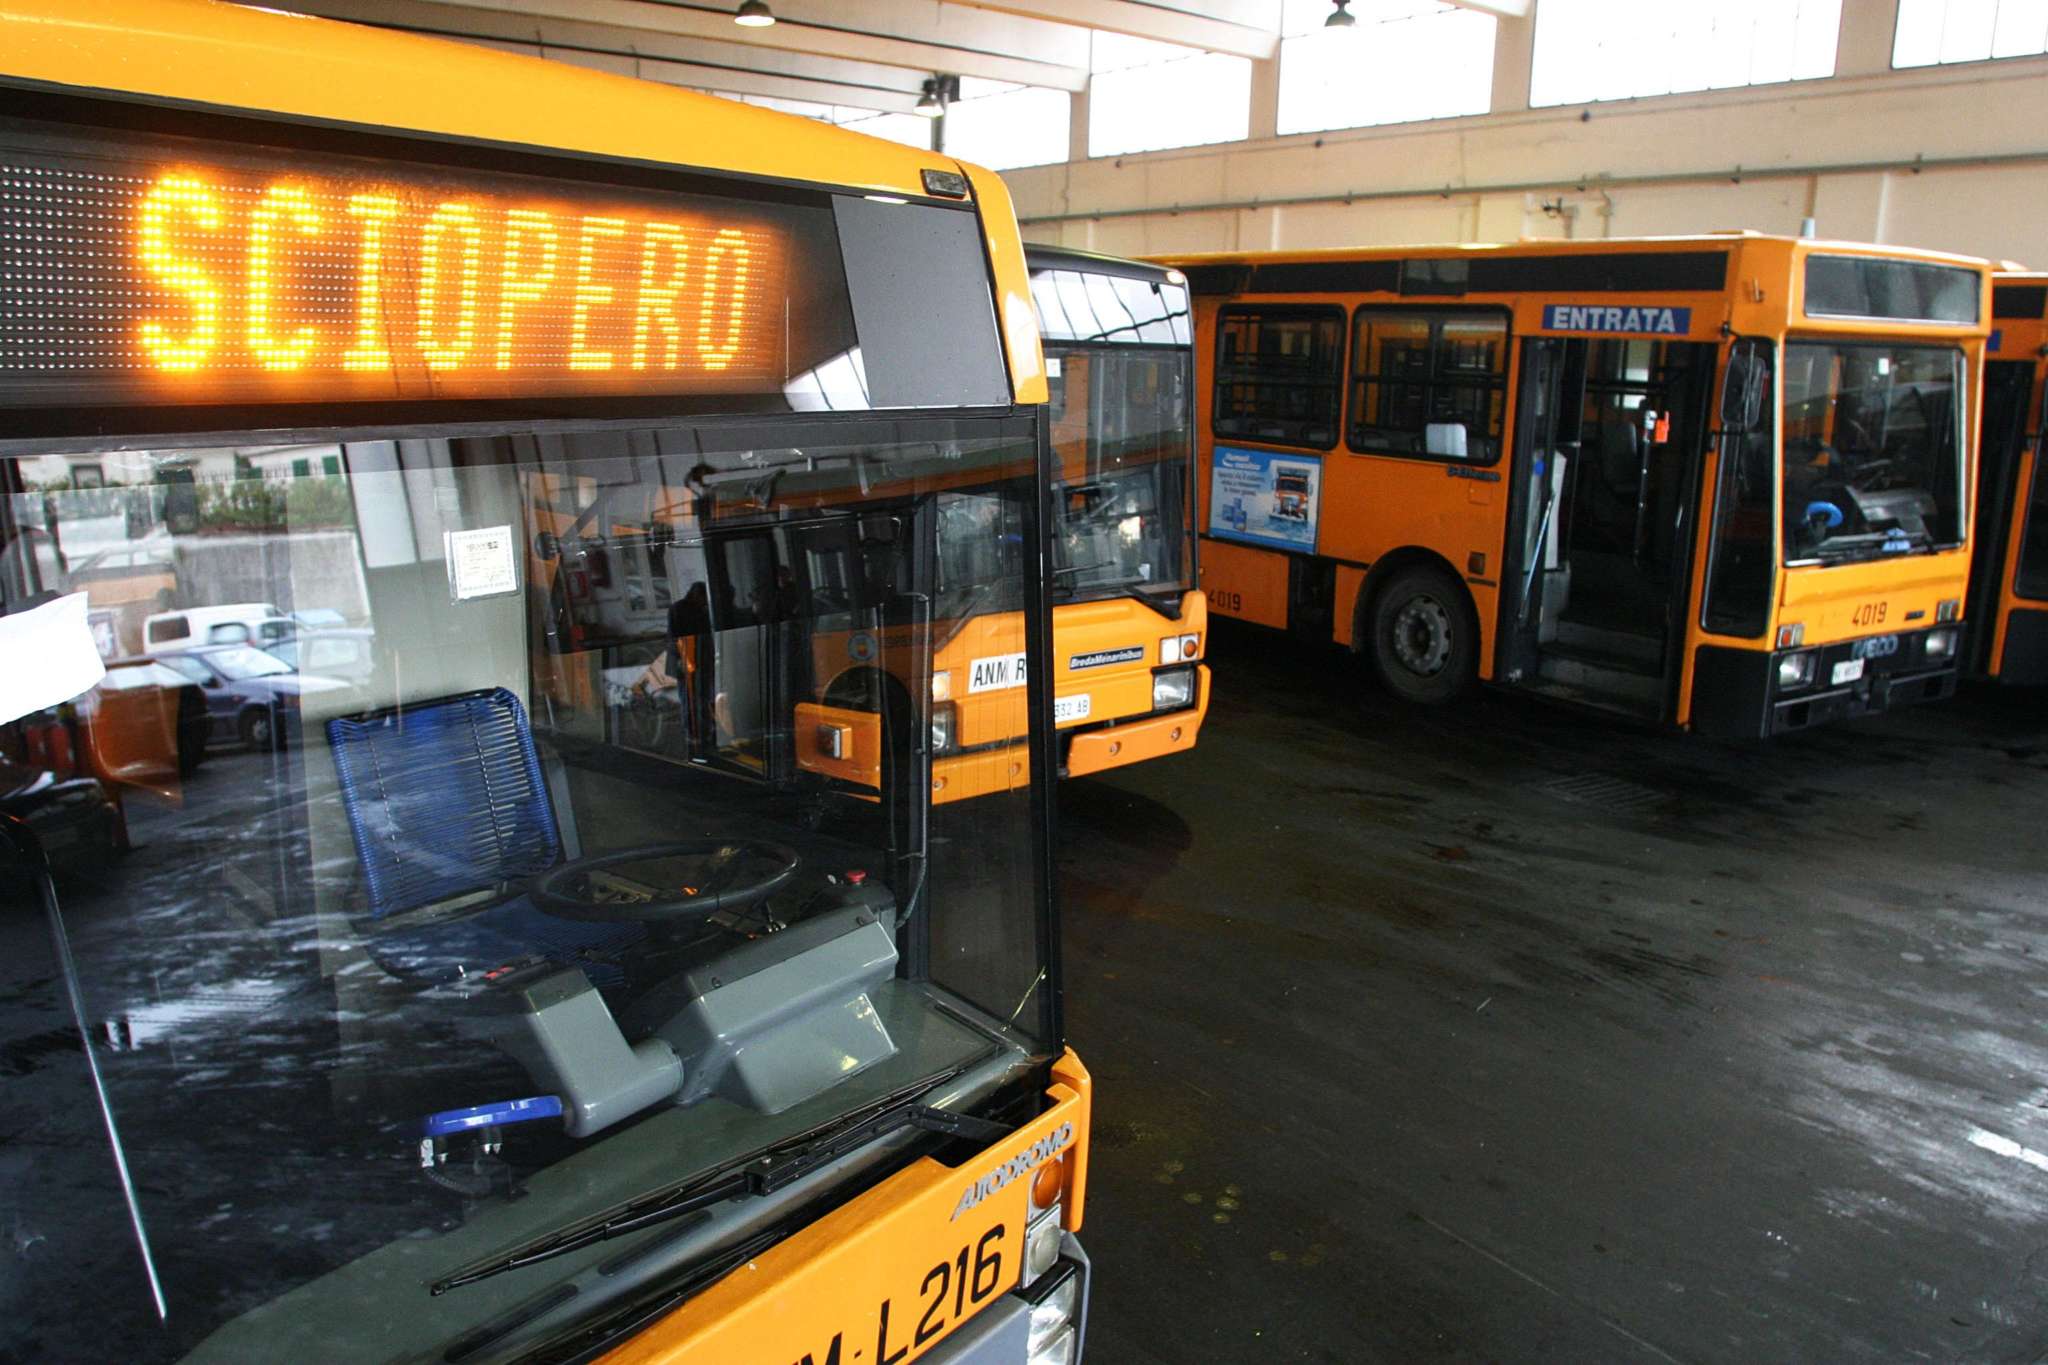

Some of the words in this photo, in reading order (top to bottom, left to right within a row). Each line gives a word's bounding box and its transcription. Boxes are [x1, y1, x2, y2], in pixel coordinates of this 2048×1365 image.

[138, 172, 750, 371] SCIOPERO
[1552, 305, 1676, 333] ENTRATA
[1208, 589, 1241, 612] 4019
[1851, 601, 1888, 627] 4019
[950, 1121, 1073, 1222] AUTODROMO
